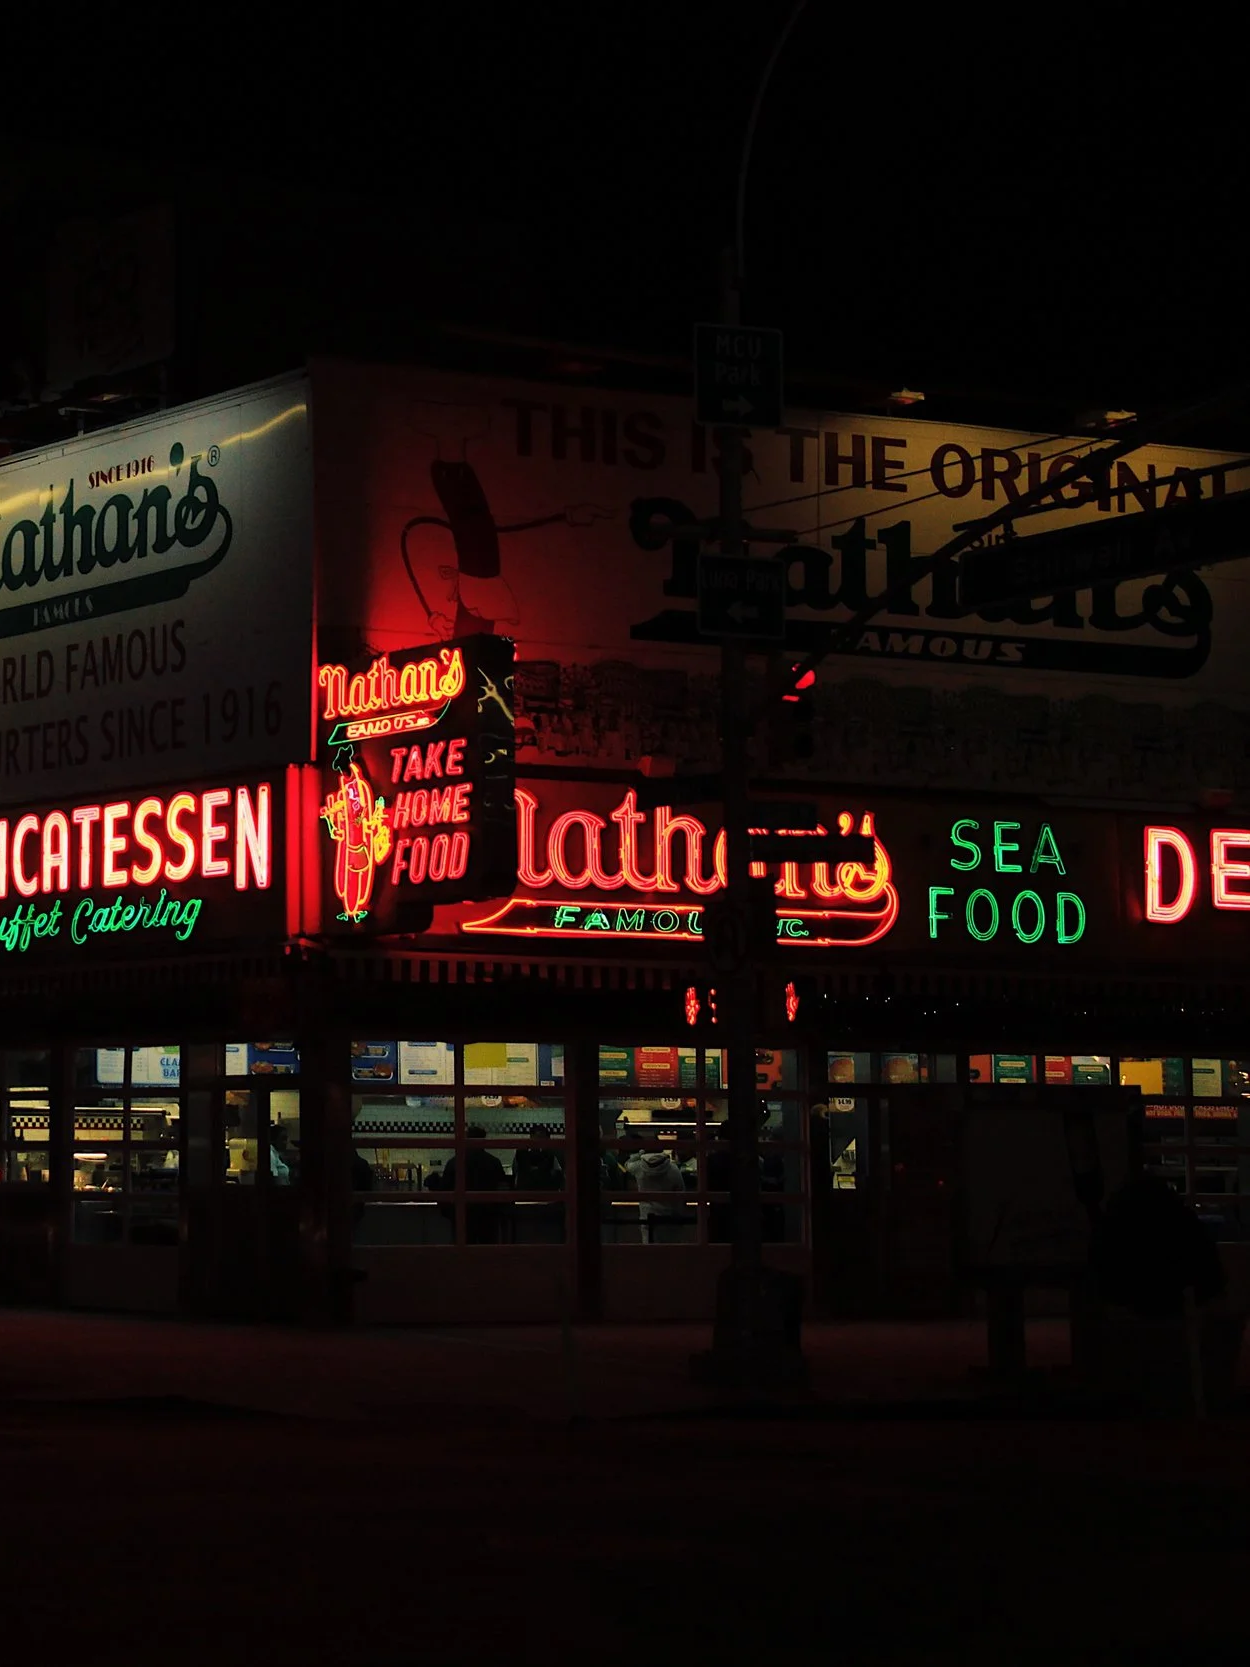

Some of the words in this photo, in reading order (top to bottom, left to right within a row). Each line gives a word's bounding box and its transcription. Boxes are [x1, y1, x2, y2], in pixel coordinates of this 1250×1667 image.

[716, 334, 762, 358] MCU
[715, 361, 762, 387] Park
[89, 465, 124, 490] SINCE
[126, 455, 155, 482] 1916
[501, 399, 666, 470] THIS
[776, 428, 907, 493] THE
[66, 619, 187, 692] FAMOUS
[830, 628, 1027, 663] AMOUS
[319, 648, 464, 720] Nathan's
[101, 699, 187, 763] SINCE
[204, 681, 283, 745] 1916
[390, 738, 467, 784] TAKE
[392, 782, 473, 830] HOME
[391, 831, 470, 886] FOOD
[950, 818, 1066, 875] SEA
[1144, 825, 1250, 924] DE
[71, 887, 203, 945] Catering
[553, 904, 703, 934] FAMO
[928, 886, 1086, 944] FOOD
[160, 1057, 180, 1067] CLA
